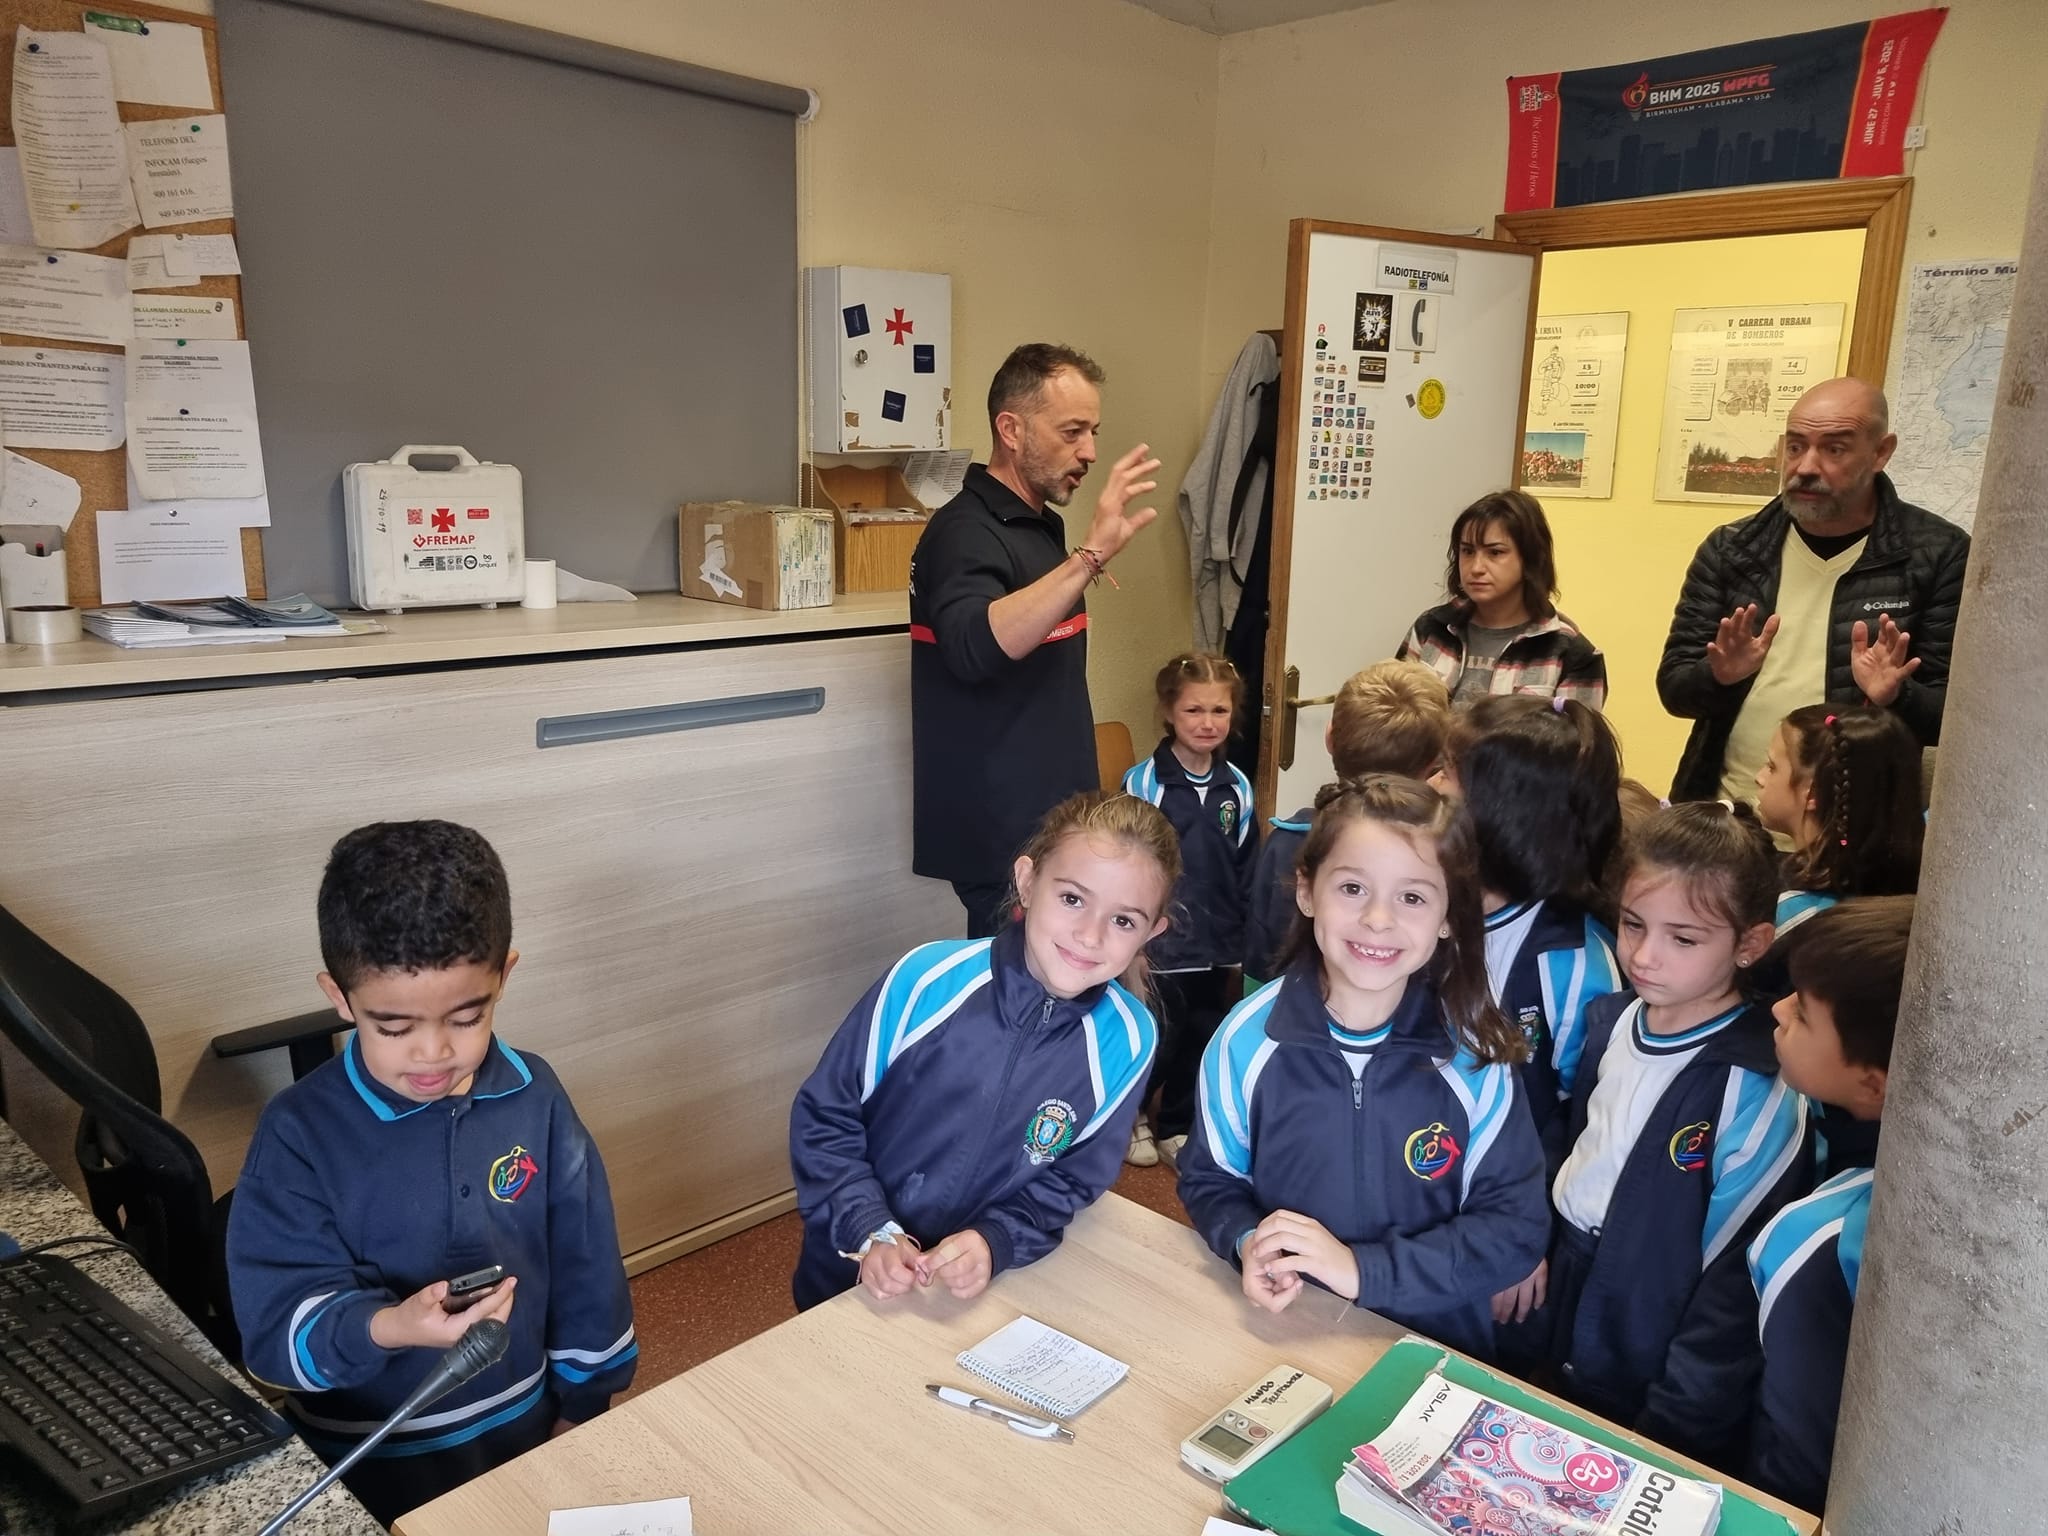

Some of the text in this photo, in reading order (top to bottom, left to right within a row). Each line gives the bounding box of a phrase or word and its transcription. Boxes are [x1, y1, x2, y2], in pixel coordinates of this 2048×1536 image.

[1880, 39, 1895, 63] 2025
[1877, 63, 1890, 74] 6,
[1650, 73, 1770, 104] BHM 2025 WPFG
[1872, 76, 1885, 100] JULY
[1646, 93, 1771, 118] BIRMINGHAM ALABAMA USA
[1867, 108, 1878, 120] 27
[180, 136, 196, 144] DEL
[1863, 121, 1876, 145] JUNE
[1530, 131, 1542, 159] Games
[145, 158, 181, 167] INFOCAM
[1528, 161, 1540, 170] of
[1384, 265, 1449, 283] RADIOTELEFONÍA
[1923, 268, 1989, 277] Término
[1728, 317, 1812, 327] V CARRERA URBANA
[1727, 330, 1785, 339] DE BOMBEROS
[26, 361, 71, 369] ENTRANTES
[426, 535, 475, 546] FREMAP
[1244, 1381, 1274, 1405] MANDO
[1418, 1383, 1452, 1423] ASLAK
[1572, 1459, 1613, 1488] 25
